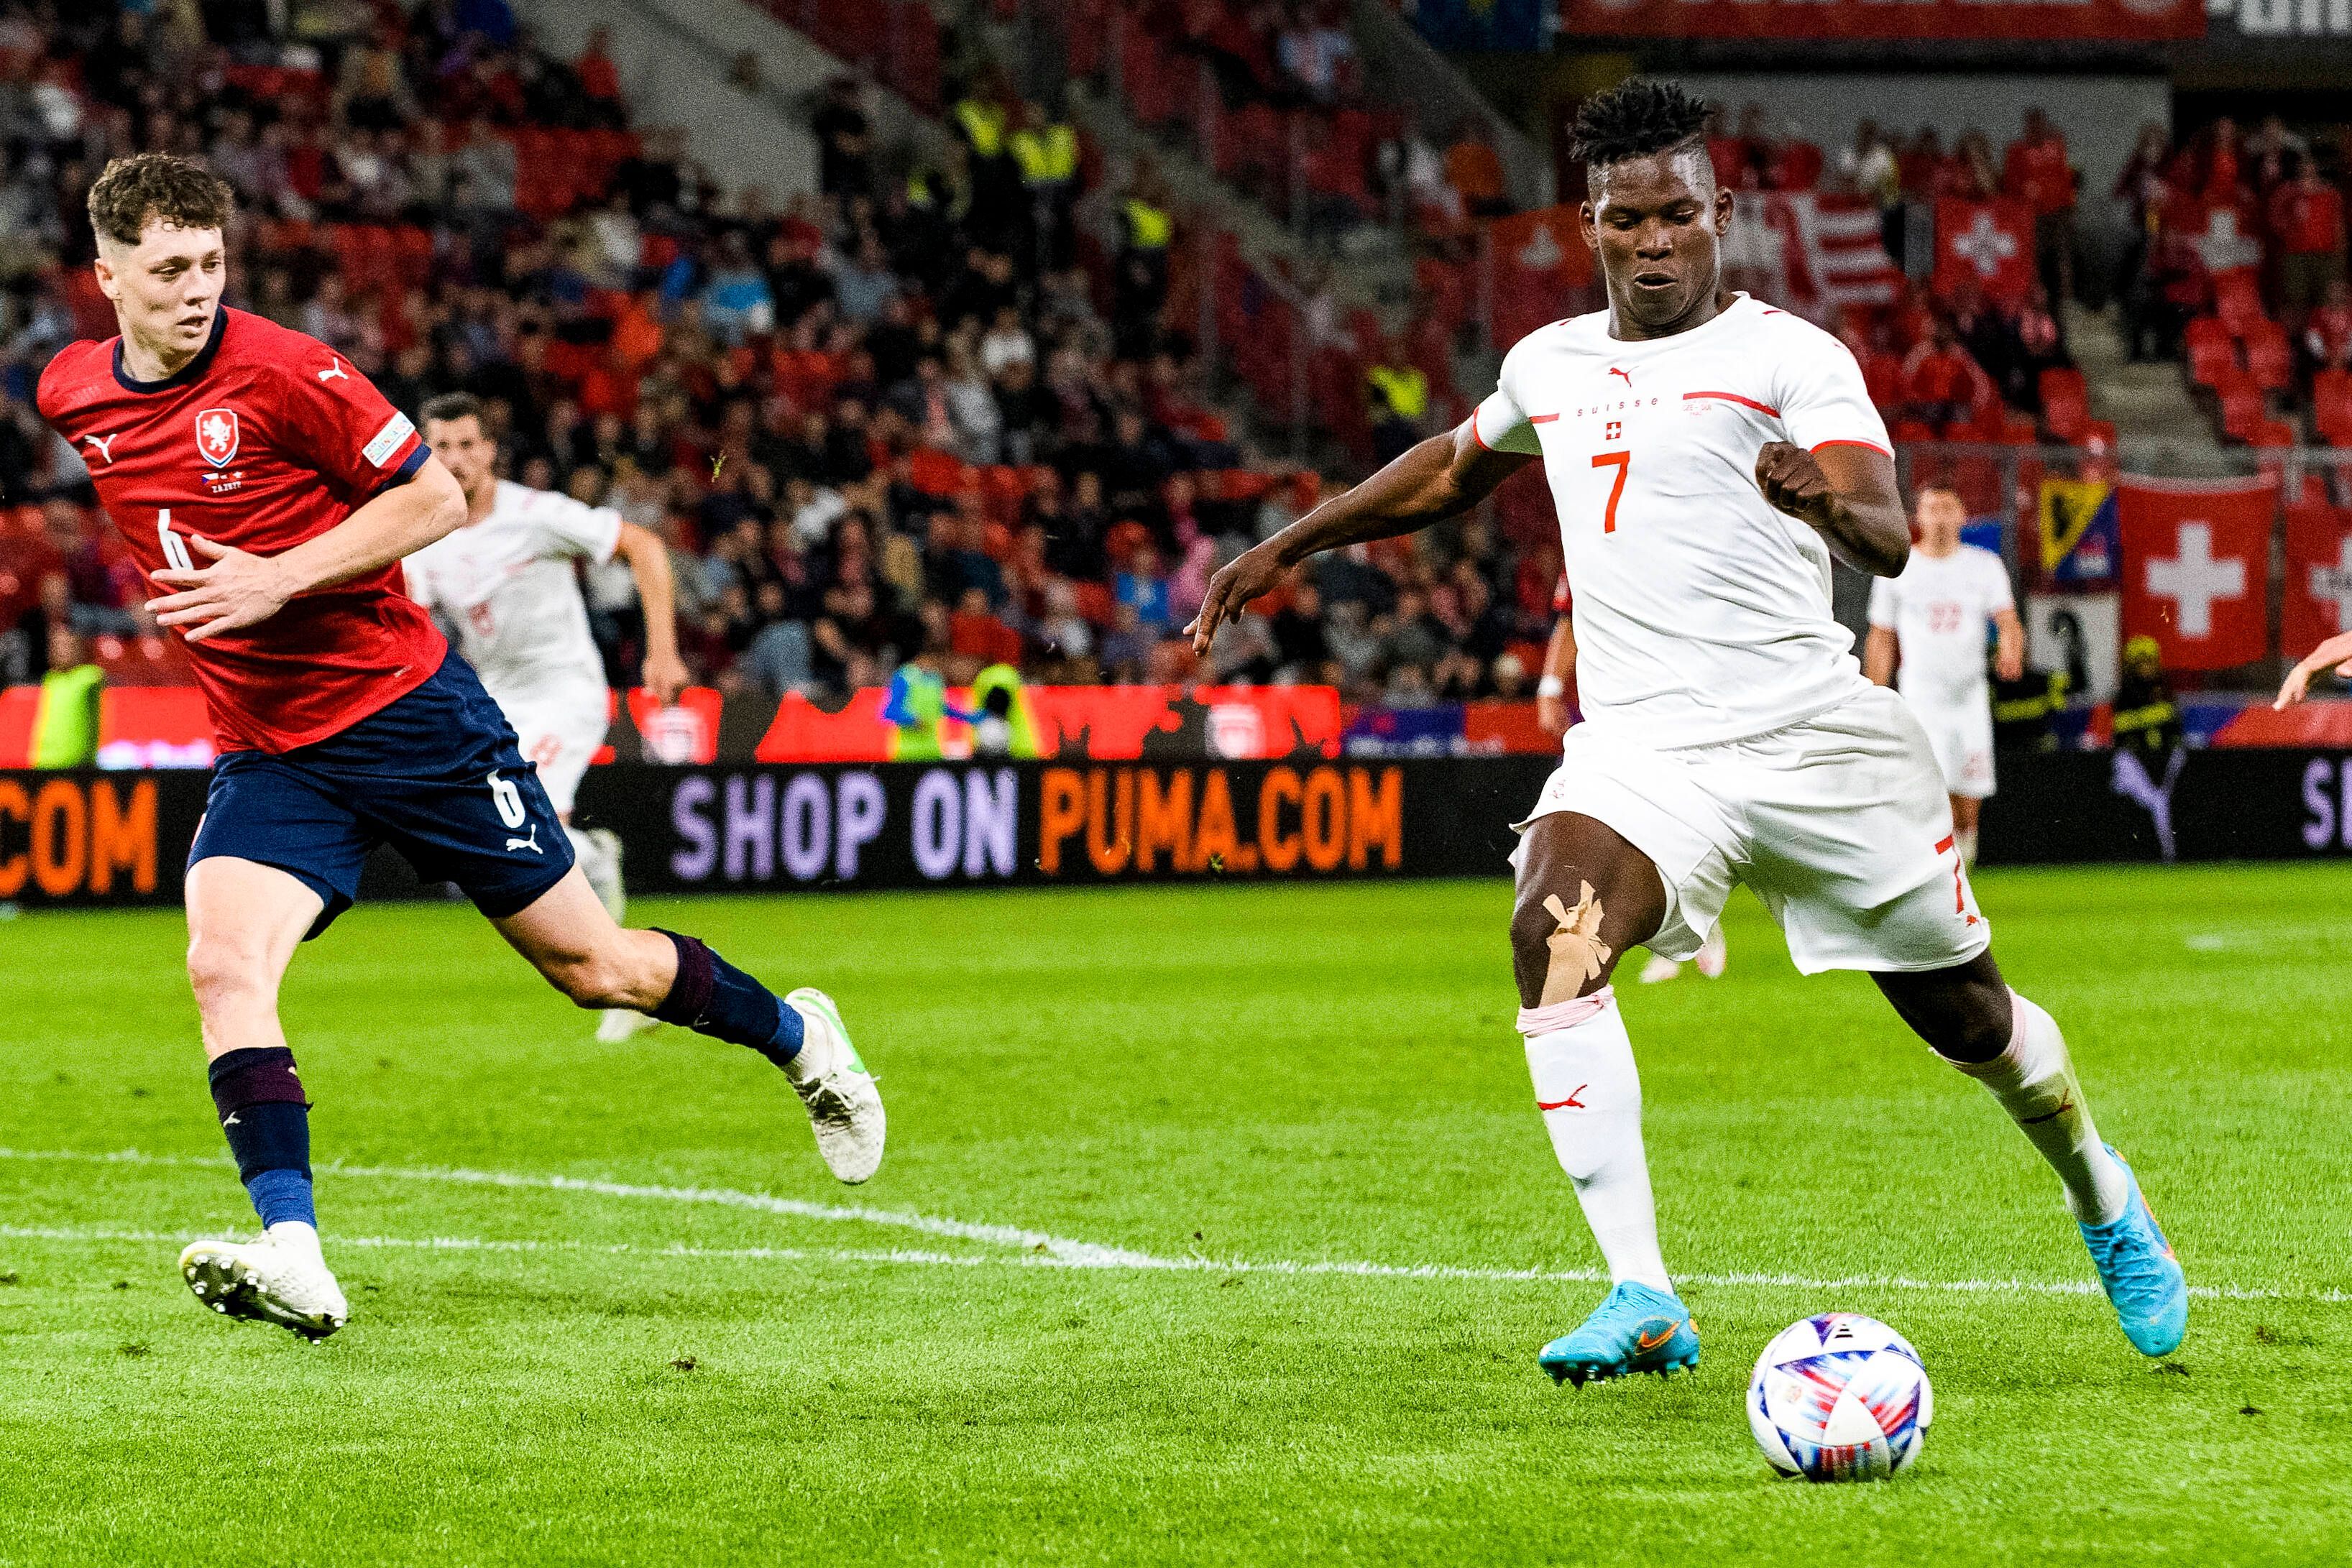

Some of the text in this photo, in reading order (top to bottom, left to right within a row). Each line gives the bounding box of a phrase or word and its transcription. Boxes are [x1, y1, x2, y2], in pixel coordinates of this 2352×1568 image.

[1577, 397, 1658, 417] suisse
[1591, 450, 1630, 533] 7
[487, 768, 525, 829] 6
[671, 765, 1402, 880] SHOP ON PUMA.COM
[2302, 757, 2352, 850] S
[1934, 834, 1965, 914] 7
